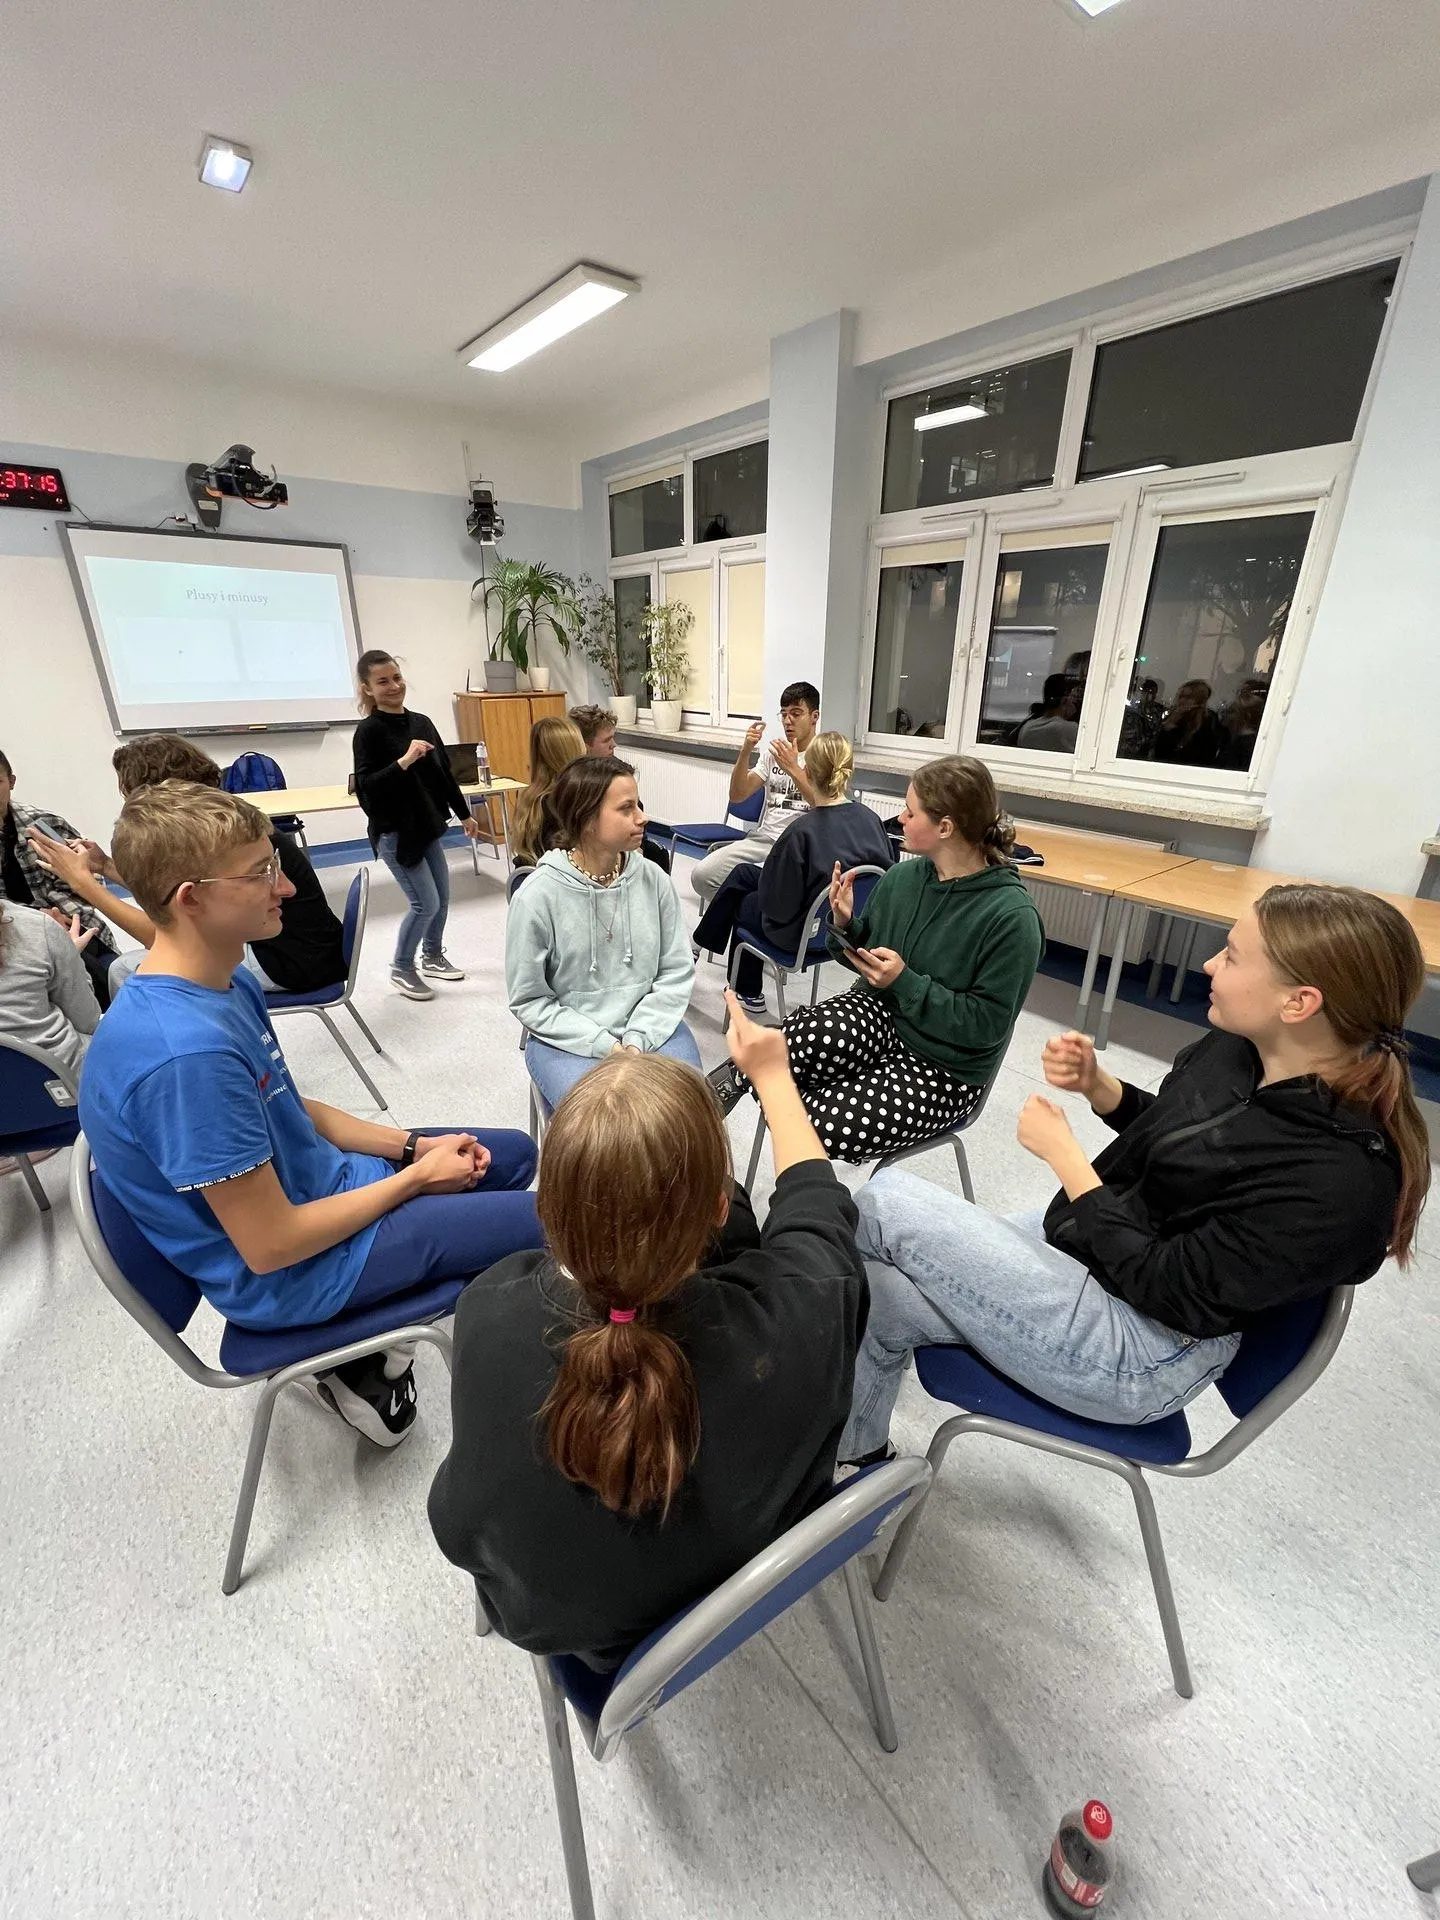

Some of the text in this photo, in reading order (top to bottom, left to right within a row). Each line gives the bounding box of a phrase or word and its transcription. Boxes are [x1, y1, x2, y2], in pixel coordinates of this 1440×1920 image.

[186, 588, 268, 605] Plusy i minusy
